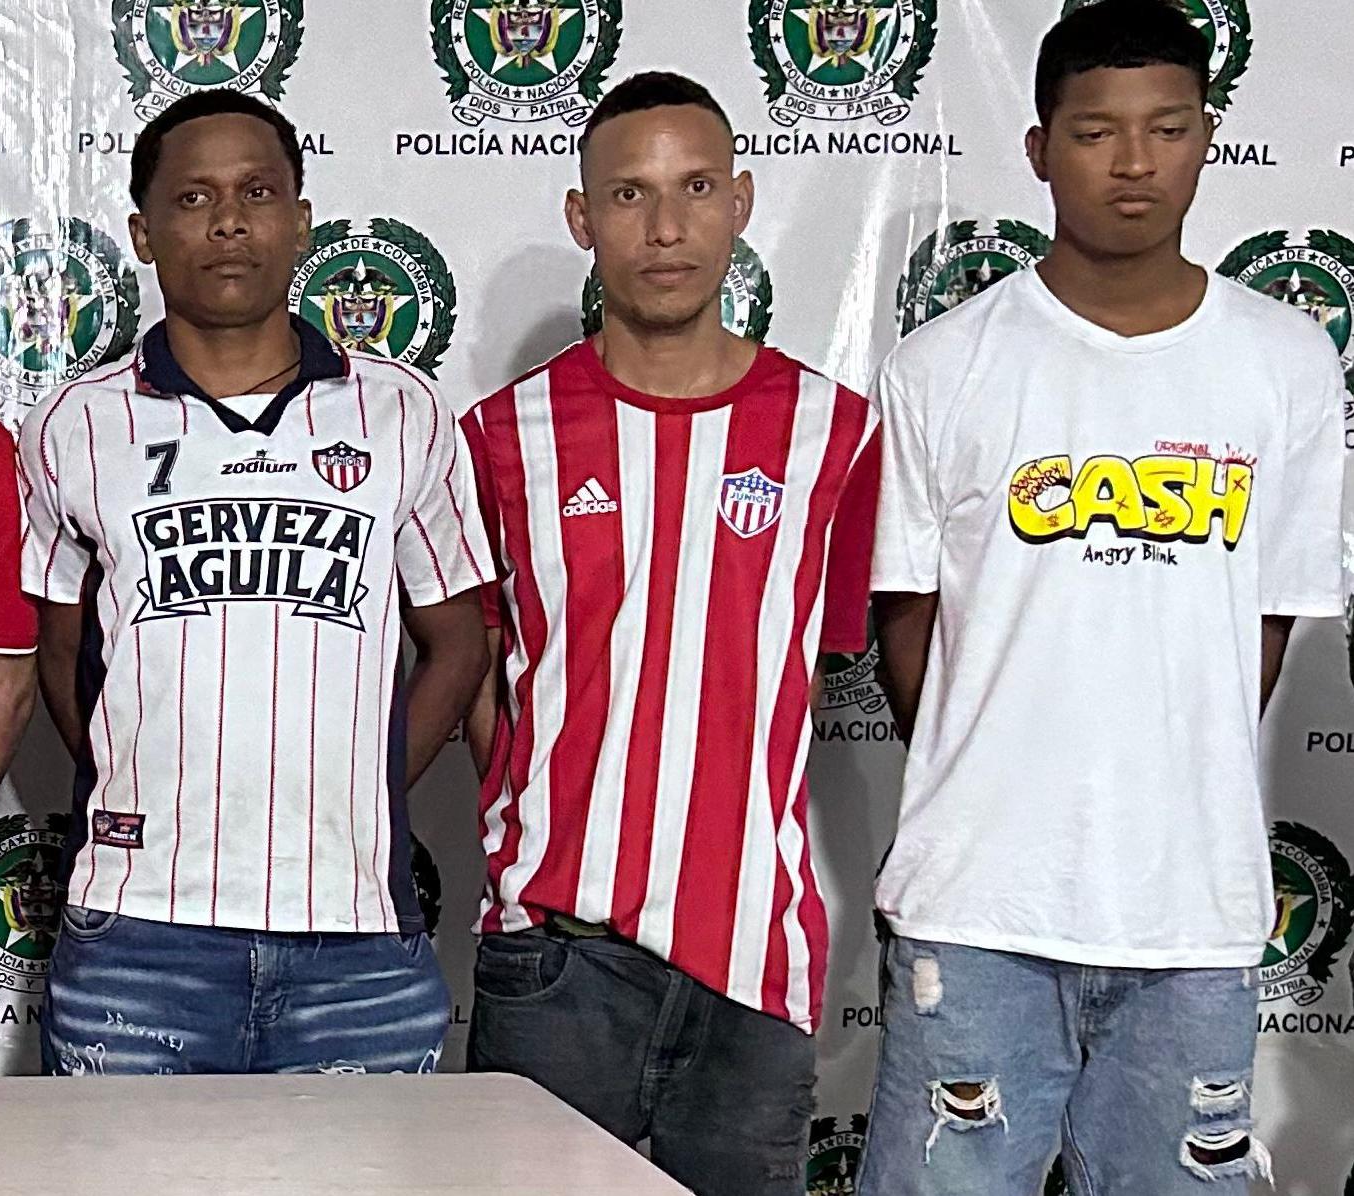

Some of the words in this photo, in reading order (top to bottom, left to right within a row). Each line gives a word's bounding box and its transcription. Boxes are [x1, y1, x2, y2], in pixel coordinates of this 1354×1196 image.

[464, 60, 511, 98] POLICIA
[527, 59, 588, 99] NACIONAL
[782, 60, 825, 98] POLICIA
[844, 57, 903, 98] NACIONAL
[469, 96, 501, 114] DIOS
[511, 107, 520, 118] Y
[530, 97, 579, 117] PATRIA
[785, 95, 816, 115] DIOS
[827, 106, 836, 117] Y
[846, 96, 894, 116] PATRIA
[396, 129, 504, 155] POLICÍA
[511, 133, 582, 156] NACI
[733, 129, 821, 156] OLICÍA
[828, 132, 963, 156] NACIONAL
[1204, 144, 1277, 166] ONAL
[976, 239, 996, 250] DE
[1286, 249, 1306, 260] DE
[289, 244, 344, 307] REPUBLICA
[351, 238, 370, 249] DE
[383, 243, 432, 305] COLOMBIA
[64, 345, 107, 379] CIONAL
[32, 391, 39, 402] Y
[145, 439, 181, 496] 7
[322, 455, 362, 467] JUNIOR
[562, 500, 618, 518] adidas
[730, 491, 772, 505] JUNIOR
[1008, 454, 1254, 552] CASH
[1082, 544, 1136, 566] Angry
[1142, 542, 1178, 566] Blink
[159, 549, 350, 609] AGUILA
[828, 685, 875, 704] PATRIA
[814, 720, 901, 741] NACION
[29, 832, 46, 843] DE
[1285, 845, 1331, 905] COLOMBIA
[1262, 941, 1319, 979] NACIONAL
[26, 979, 34, 990] Y
[1264, 977, 1308, 997] PATRIA
[836, 1133, 852, 1146] DE
